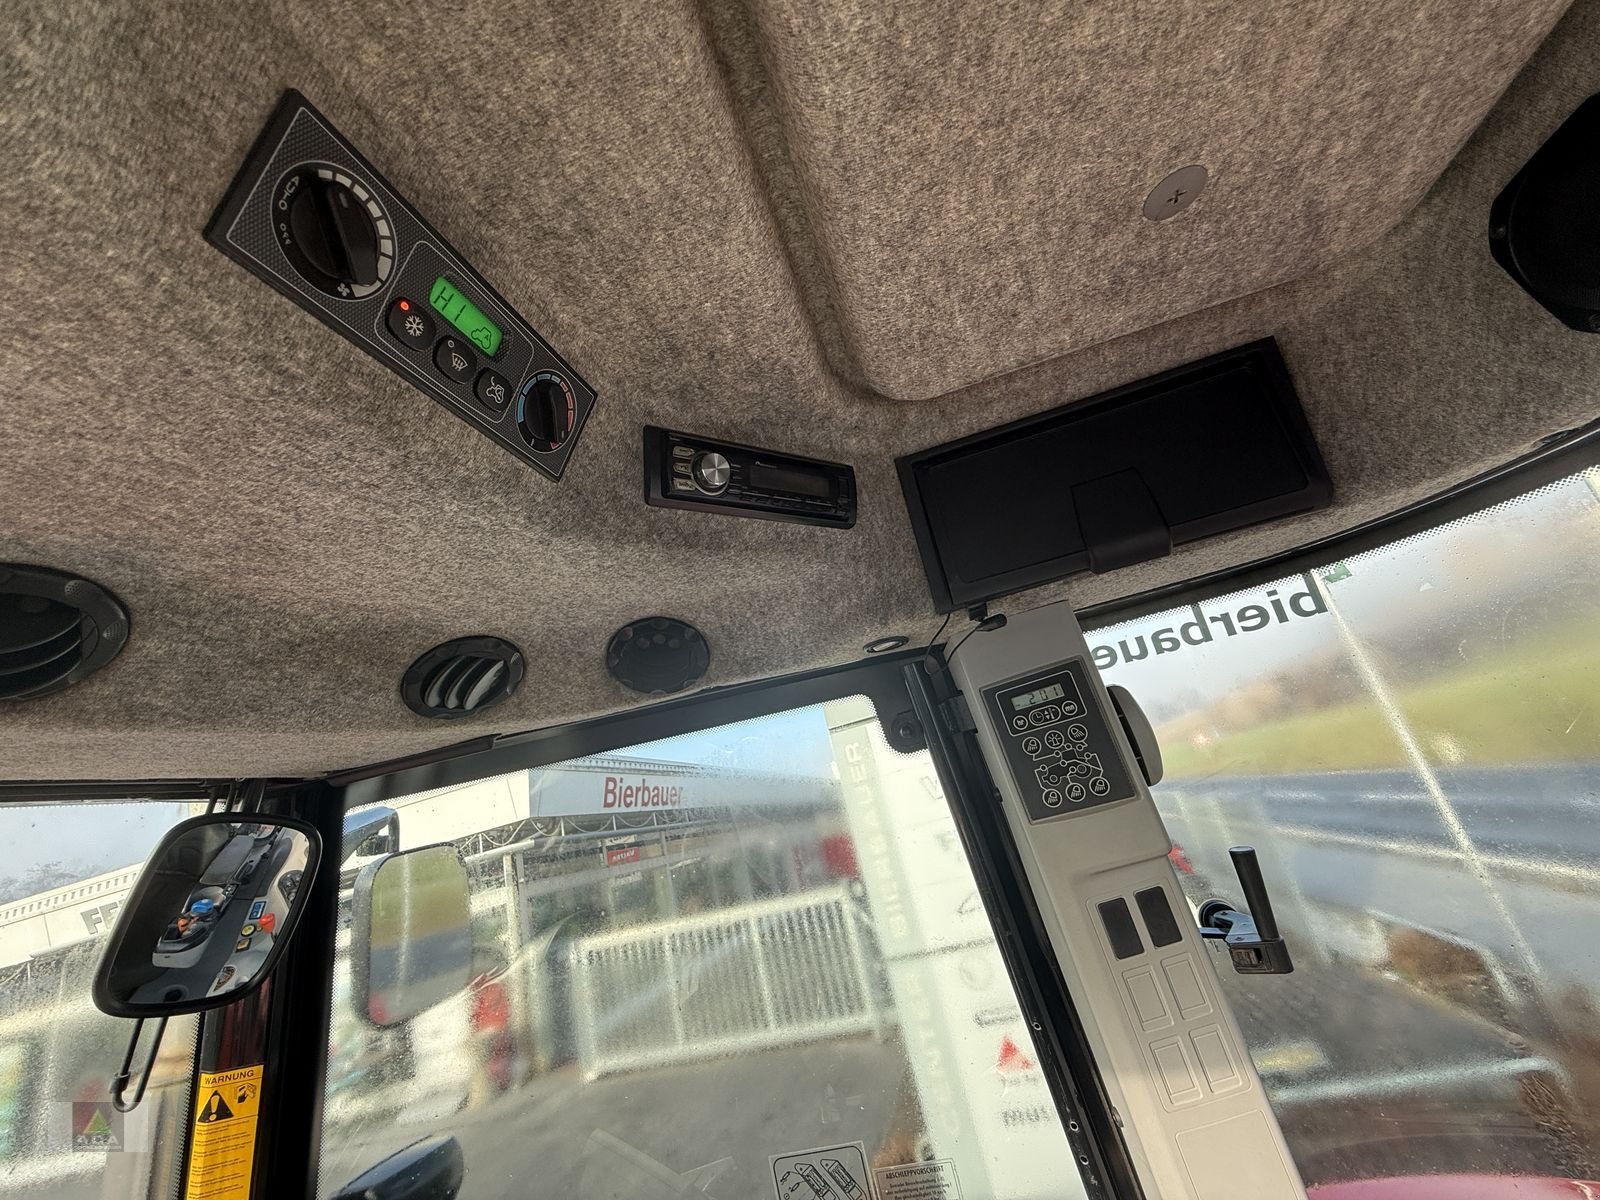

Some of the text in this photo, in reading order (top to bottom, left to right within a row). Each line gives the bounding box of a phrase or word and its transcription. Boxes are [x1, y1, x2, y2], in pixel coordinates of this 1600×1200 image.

[279, 176, 299, 211] AUTO
[280, 223, 292, 245] OFF
[433, 286, 466, 322] HI
[603, 776, 684, 808] Bierbauer
[204, 1069, 255, 1085] WARNUNG
